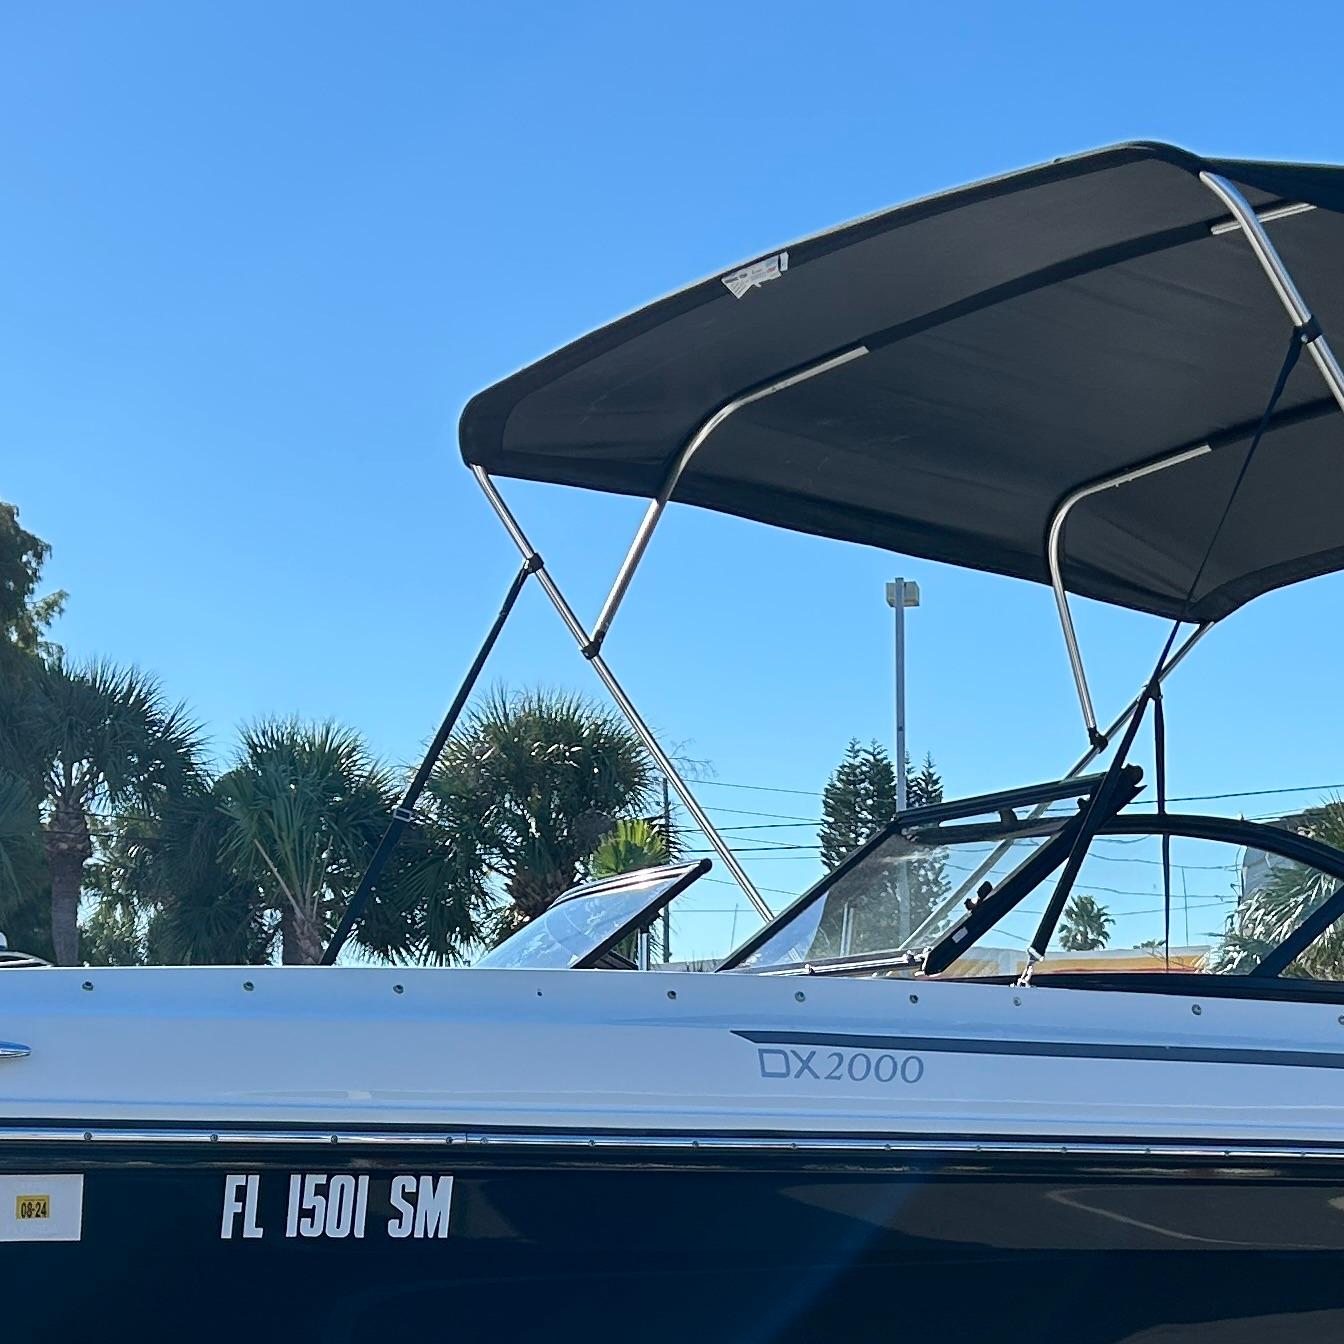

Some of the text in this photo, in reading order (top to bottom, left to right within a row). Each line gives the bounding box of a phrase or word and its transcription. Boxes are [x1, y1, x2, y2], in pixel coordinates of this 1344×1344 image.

[20, 1202, 48, 1219] 08-24
[221, 1174, 454, 1238] FL 1501 SM
